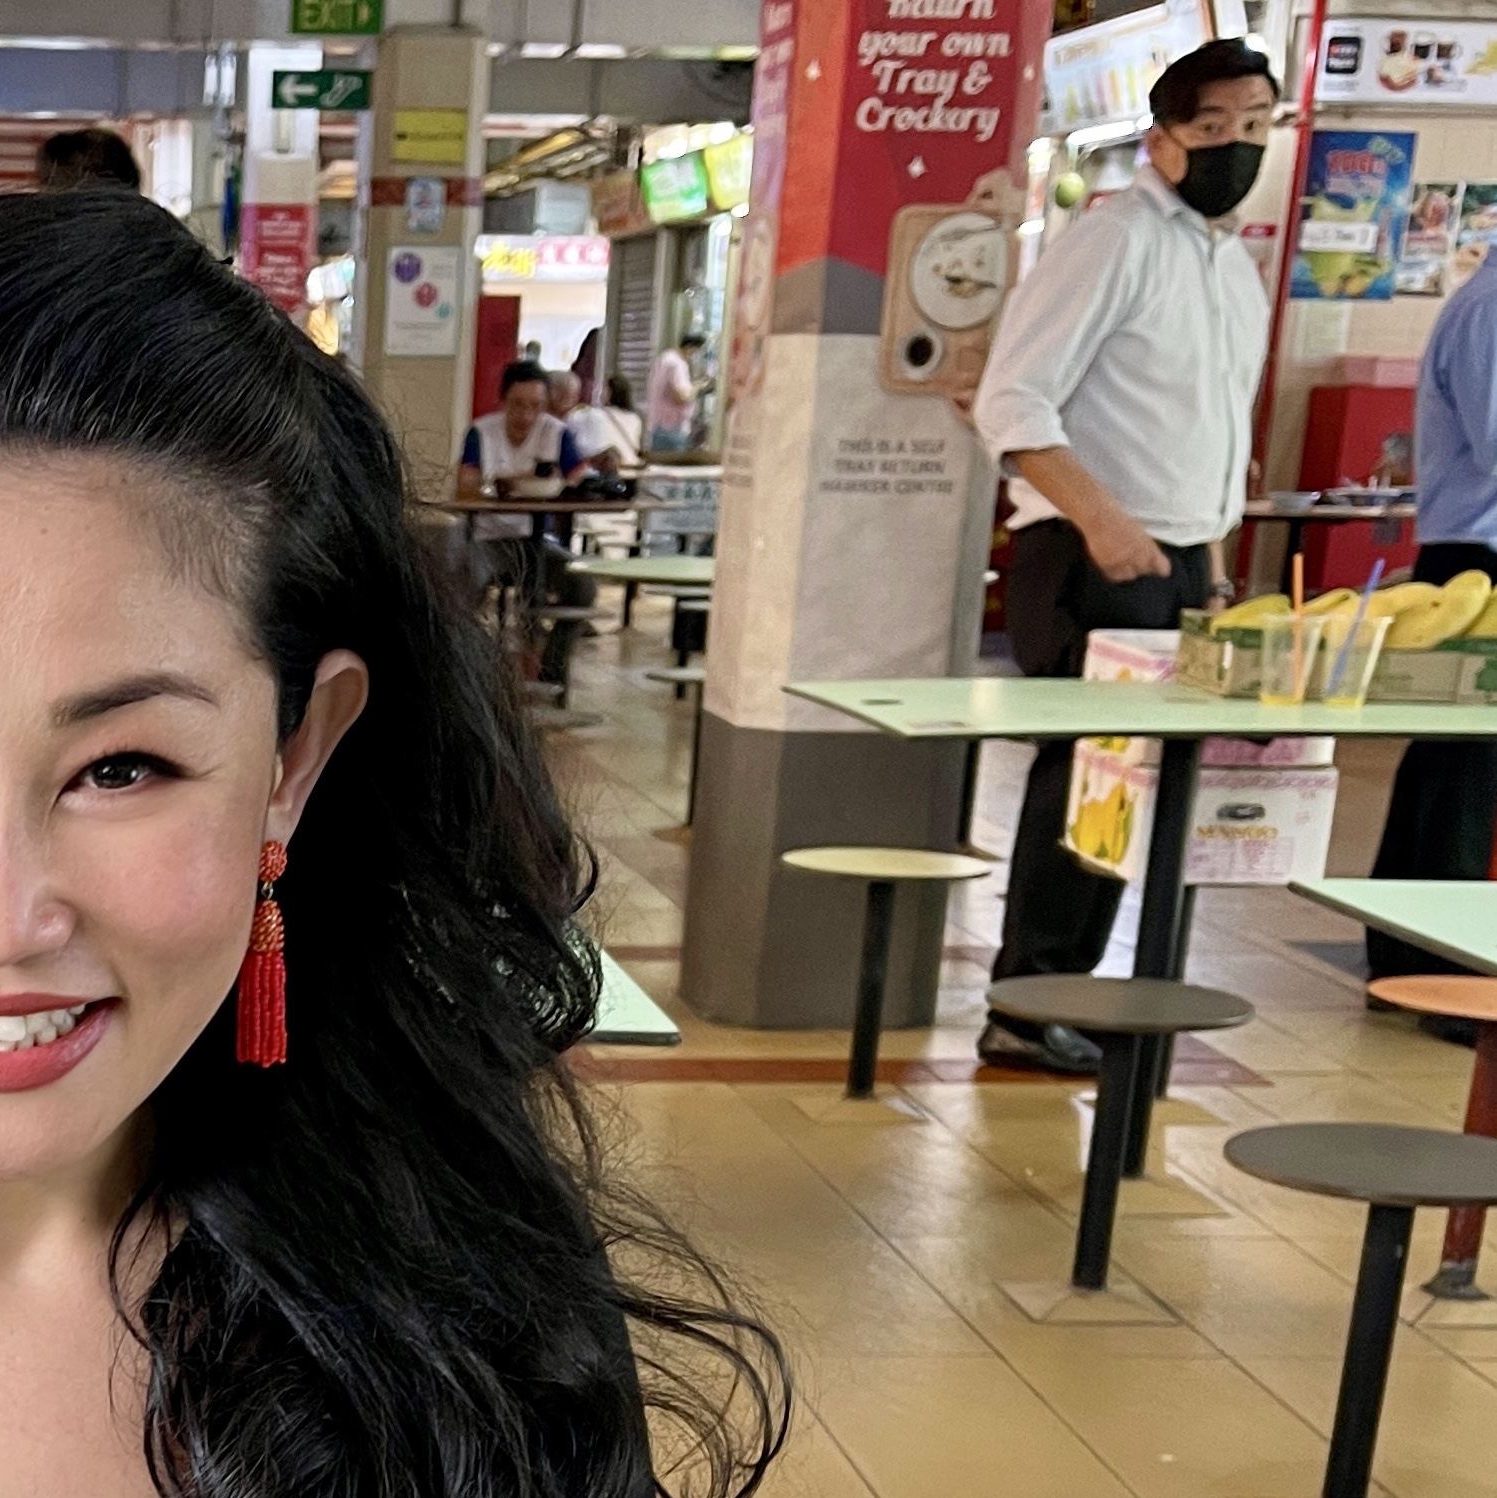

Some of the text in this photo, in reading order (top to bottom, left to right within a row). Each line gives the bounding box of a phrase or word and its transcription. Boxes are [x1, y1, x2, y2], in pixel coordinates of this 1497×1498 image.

[858, 31, 1012, 66] your own
[872, 60, 993, 106] Tray &
[855, 97, 1000, 142] Crockery
